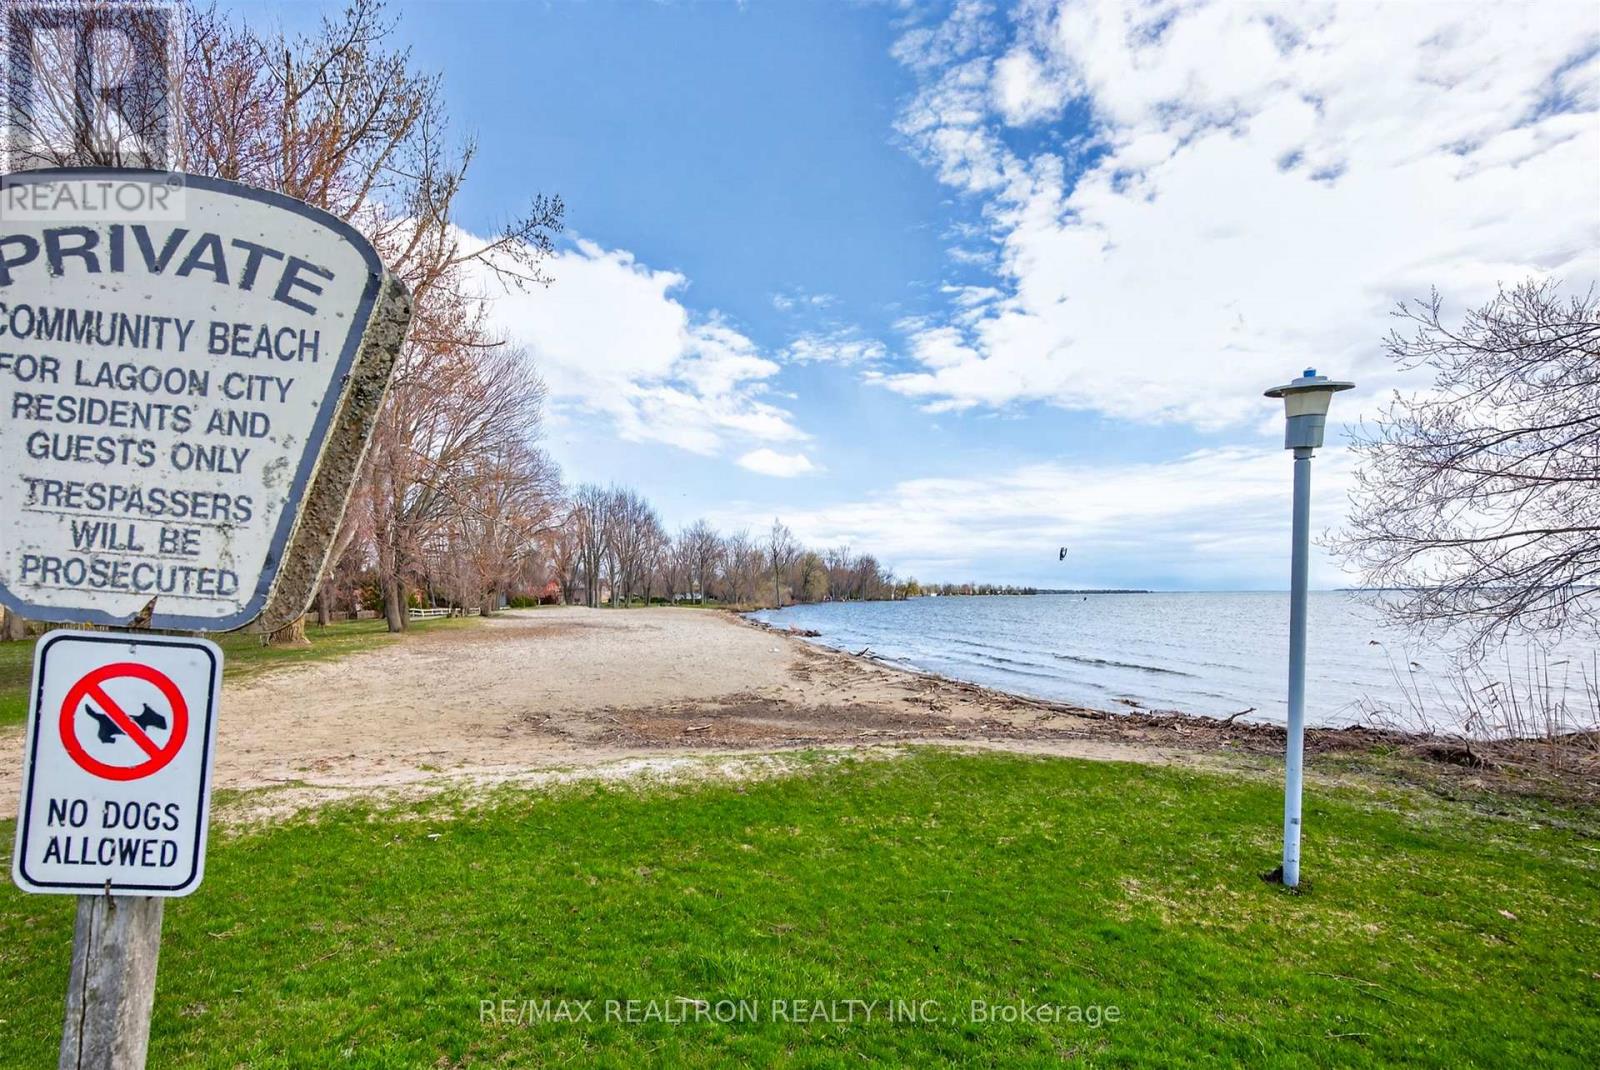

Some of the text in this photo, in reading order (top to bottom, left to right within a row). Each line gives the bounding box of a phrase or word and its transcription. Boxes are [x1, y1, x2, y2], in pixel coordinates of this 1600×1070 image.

[0, 225, 335, 316] PRIVATE
[208, 321, 320, 363] BEACH
[75, 359, 209, 397] LAGOON
[223, 372, 295, 403] CITY
[12, 392, 271, 439] RESIDENTS AND
[26, 432, 250, 474] GUESTS ONLY
[24, 478, 253, 523] TRESPASSERS
[71, 520, 201, 556] WILL BE
[20, 554, 239, 596] PROSECUTED
[47, 798, 180, 831] NO DOGS
[42, 835, 178, 868] ALLOWED
